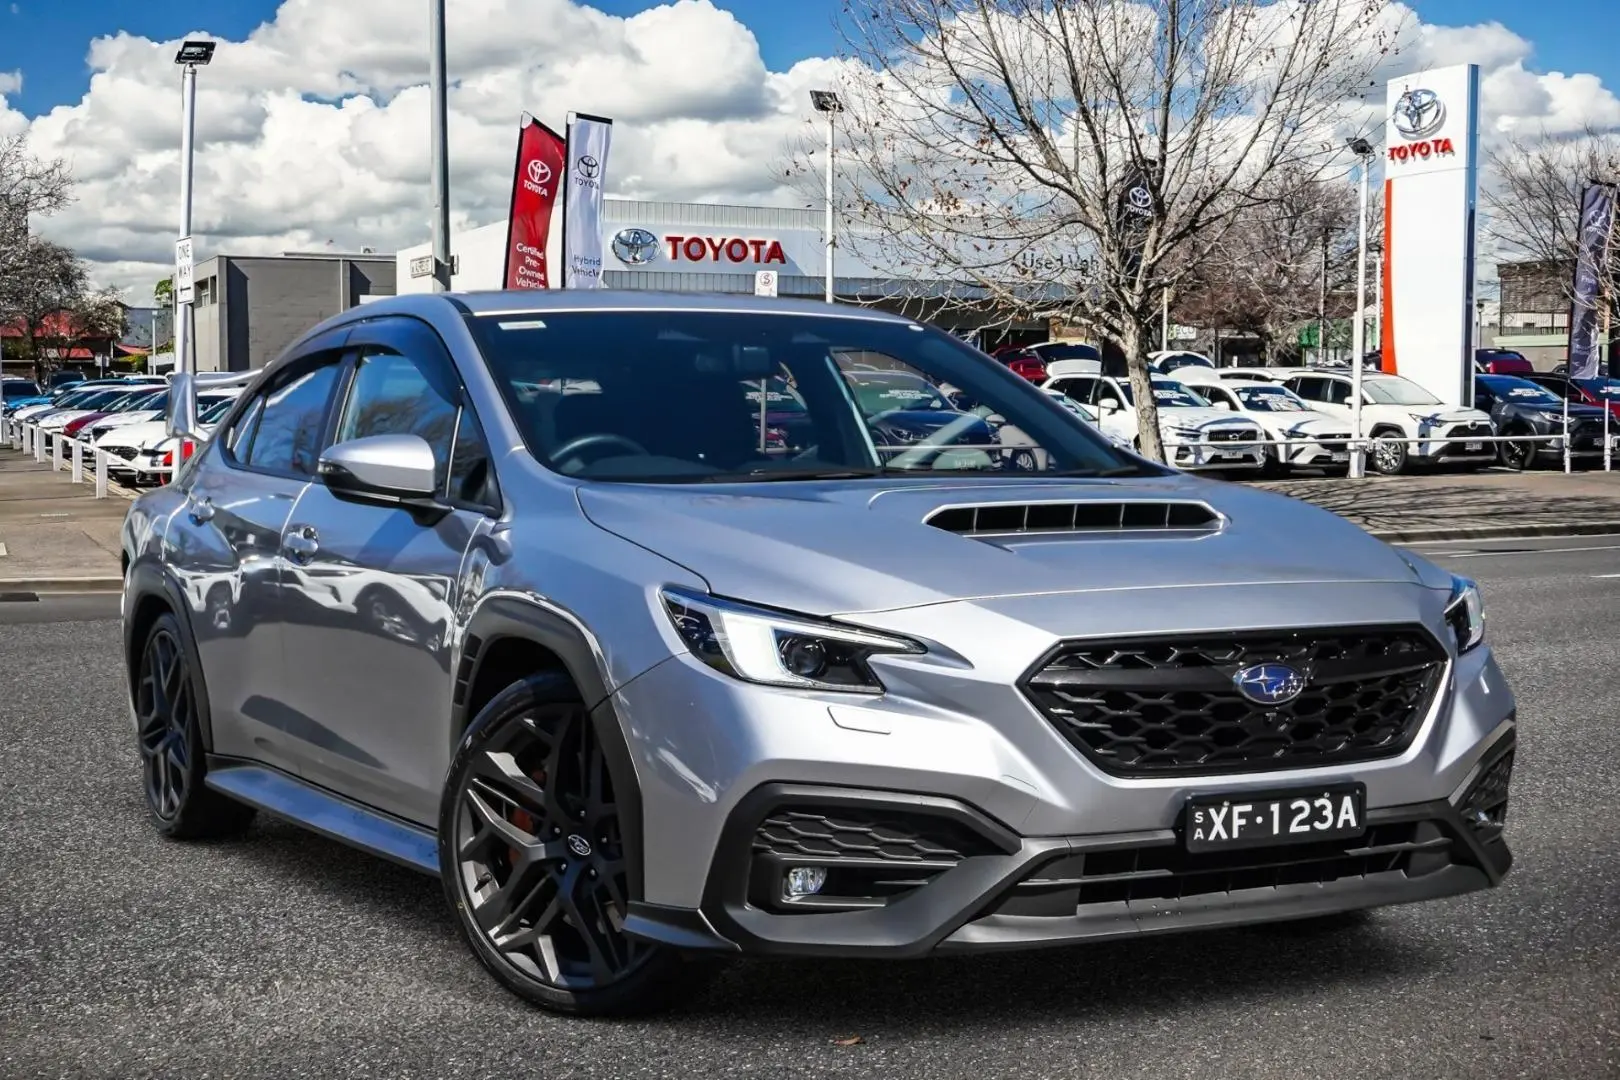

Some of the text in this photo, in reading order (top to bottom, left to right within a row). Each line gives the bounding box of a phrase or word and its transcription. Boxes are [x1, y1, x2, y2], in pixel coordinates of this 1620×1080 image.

[1388, 138, 1453, 161] TOYOTA
[523, 179, 548, 197] TOYOTA
[574, 177, 600, 190] TOYOTA
[1124, 203, 1153, 217] TOYOTA
[178, 243, 190, 260] ONE
[666, 236, 787, 264] TOYOTA
[525, 256, 541, 267] Pre-
[573, 254, 601, 267] Hybrid
[1022, 252, 1064, 270] Used
[179, 264, 191, 279] WAY
[518, 266, 545, 281] Owned
